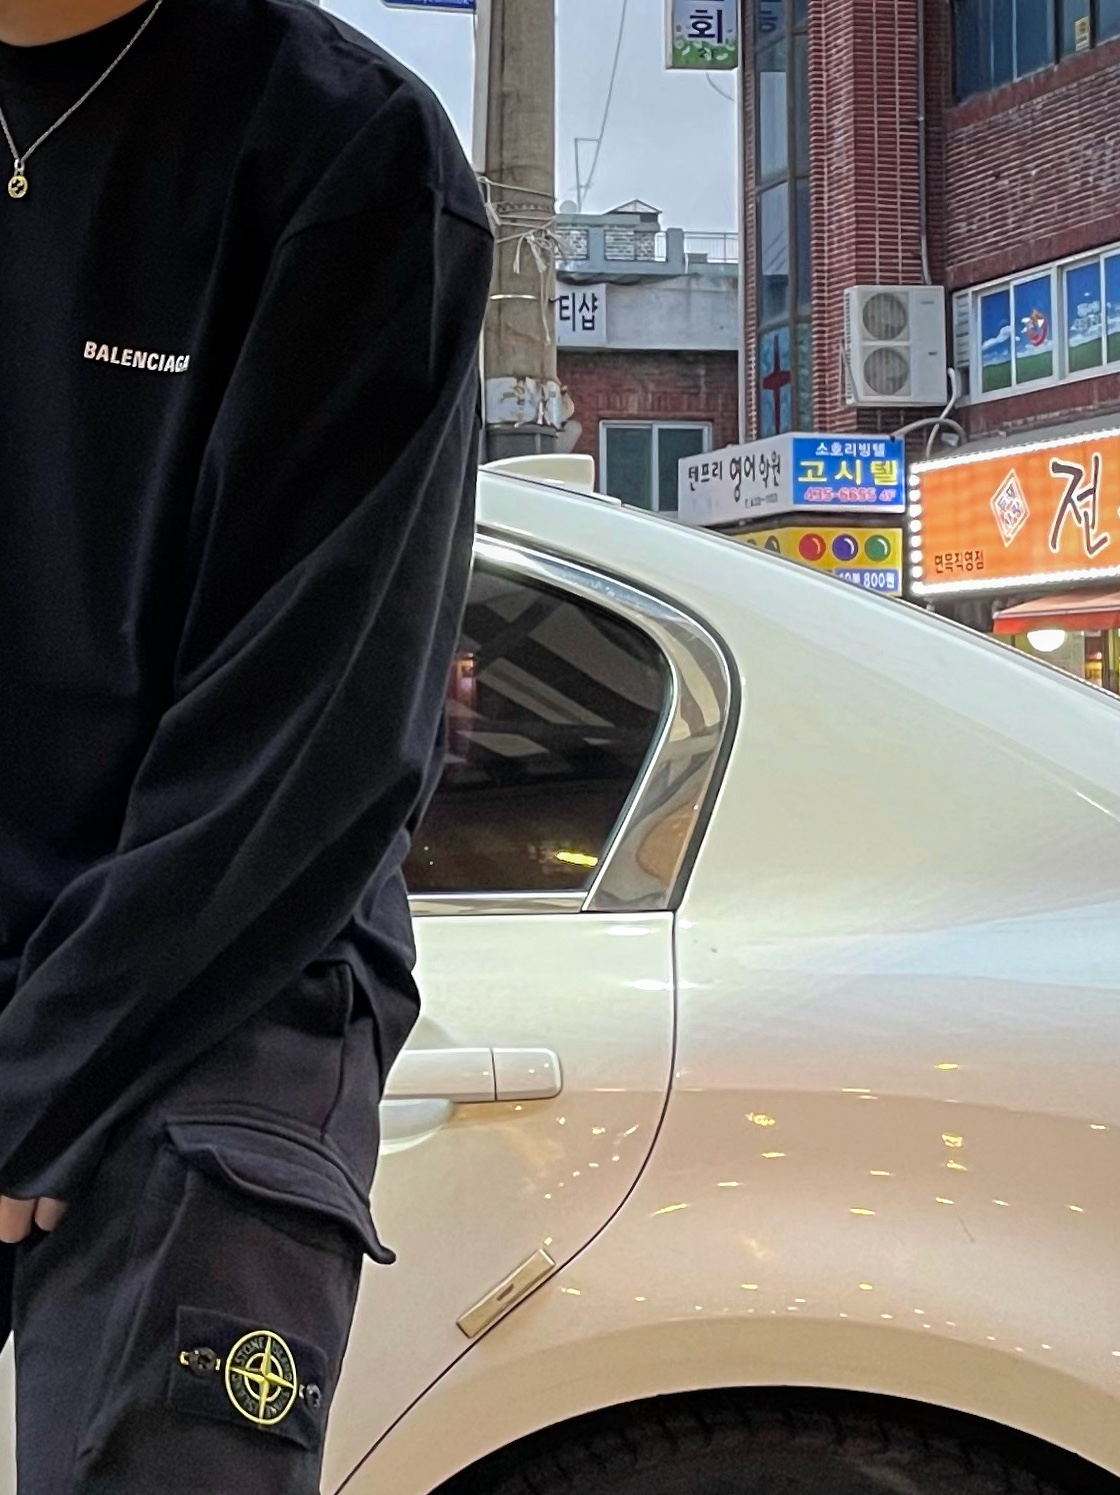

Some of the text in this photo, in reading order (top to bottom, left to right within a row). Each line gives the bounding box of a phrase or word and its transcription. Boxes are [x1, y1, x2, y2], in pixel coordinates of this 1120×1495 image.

[688, 9, 723, 44] 회
[559, 292, 599, 332] 티샵
[797, 459, 899, 486] 고시텔
[934, 550, 985, 574] 면목직영점
